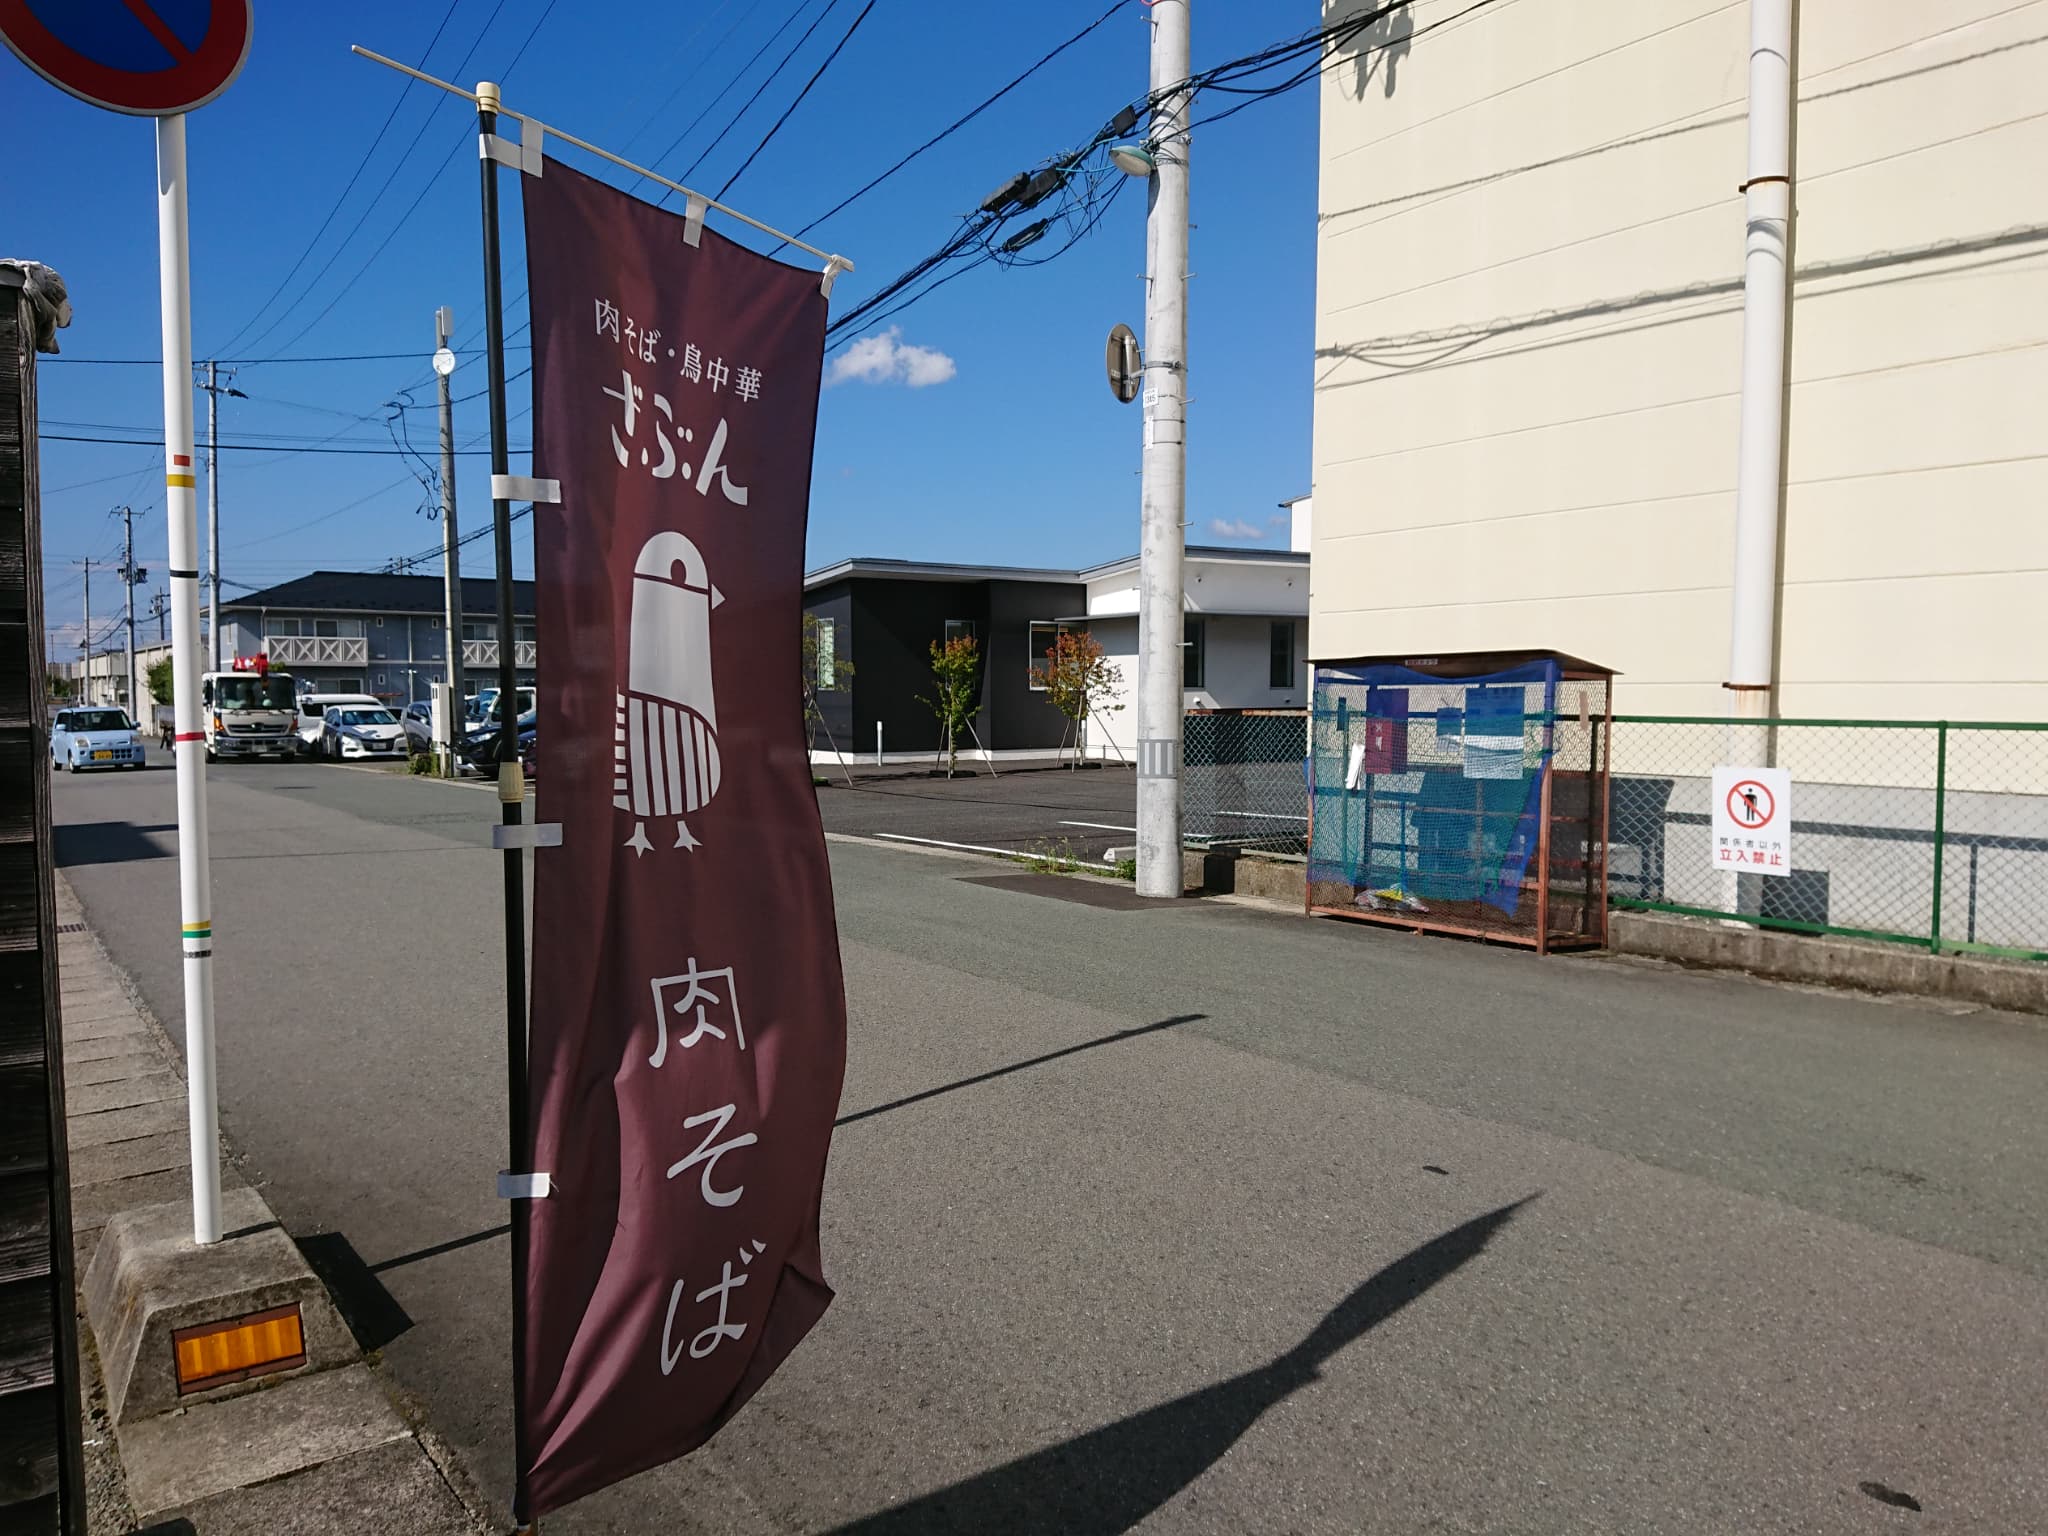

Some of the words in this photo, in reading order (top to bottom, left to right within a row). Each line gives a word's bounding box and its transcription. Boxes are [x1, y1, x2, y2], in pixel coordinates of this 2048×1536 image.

[595, 298, 762, 402] 肉そば・鳥中華
[602, 369, 748, 506] ざぶん
[1719, 837, 1782, 850] 関係者以外
[1719, 848, 1783, 866] 立入禁止
[648, 957, 767, 1376] 肉そば
